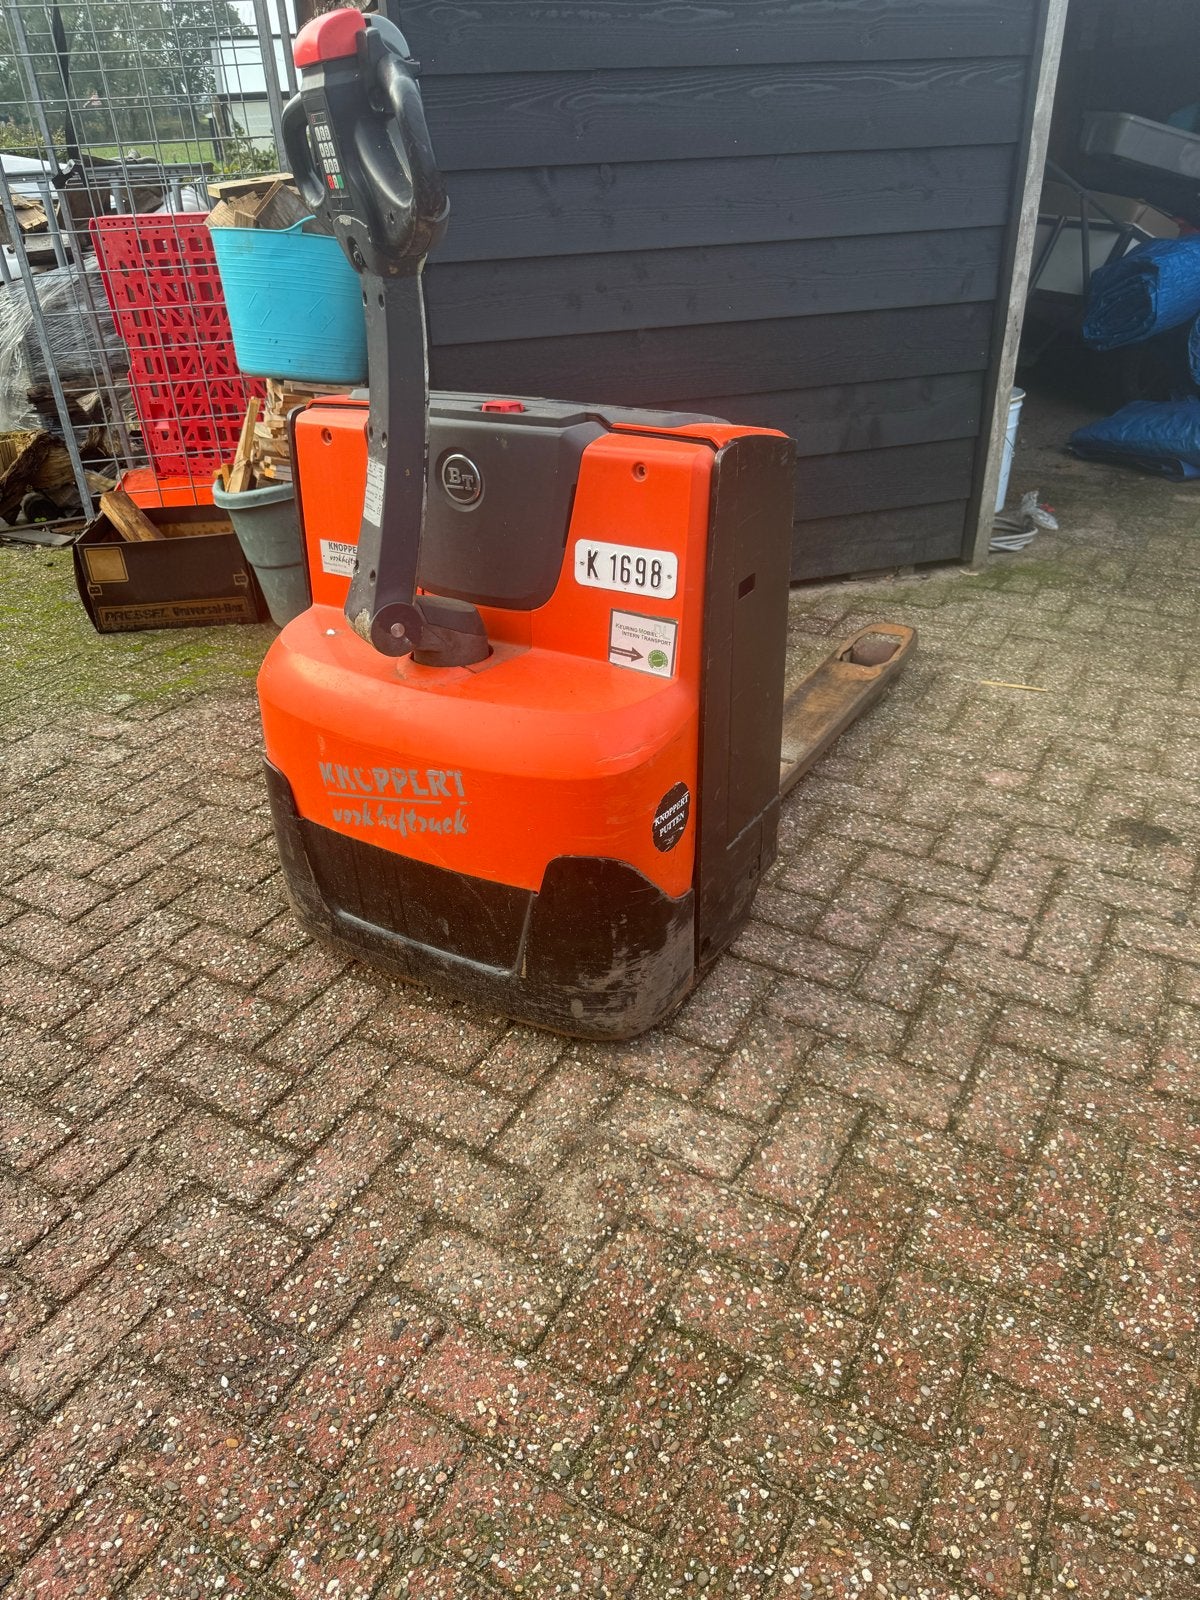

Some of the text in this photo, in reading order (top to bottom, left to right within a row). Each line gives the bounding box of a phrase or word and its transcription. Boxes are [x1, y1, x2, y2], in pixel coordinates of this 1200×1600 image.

[448, 467, 474, 490] BT
[328, 541, 358, 554] KNOPPE
[586, 549, 662, 588] K 1698
[641, 634, 672, 646] TRANSPORT
[654, 793, 689, 827] KNOPPERT
[659, 810, 685, 838] PUTTEN
